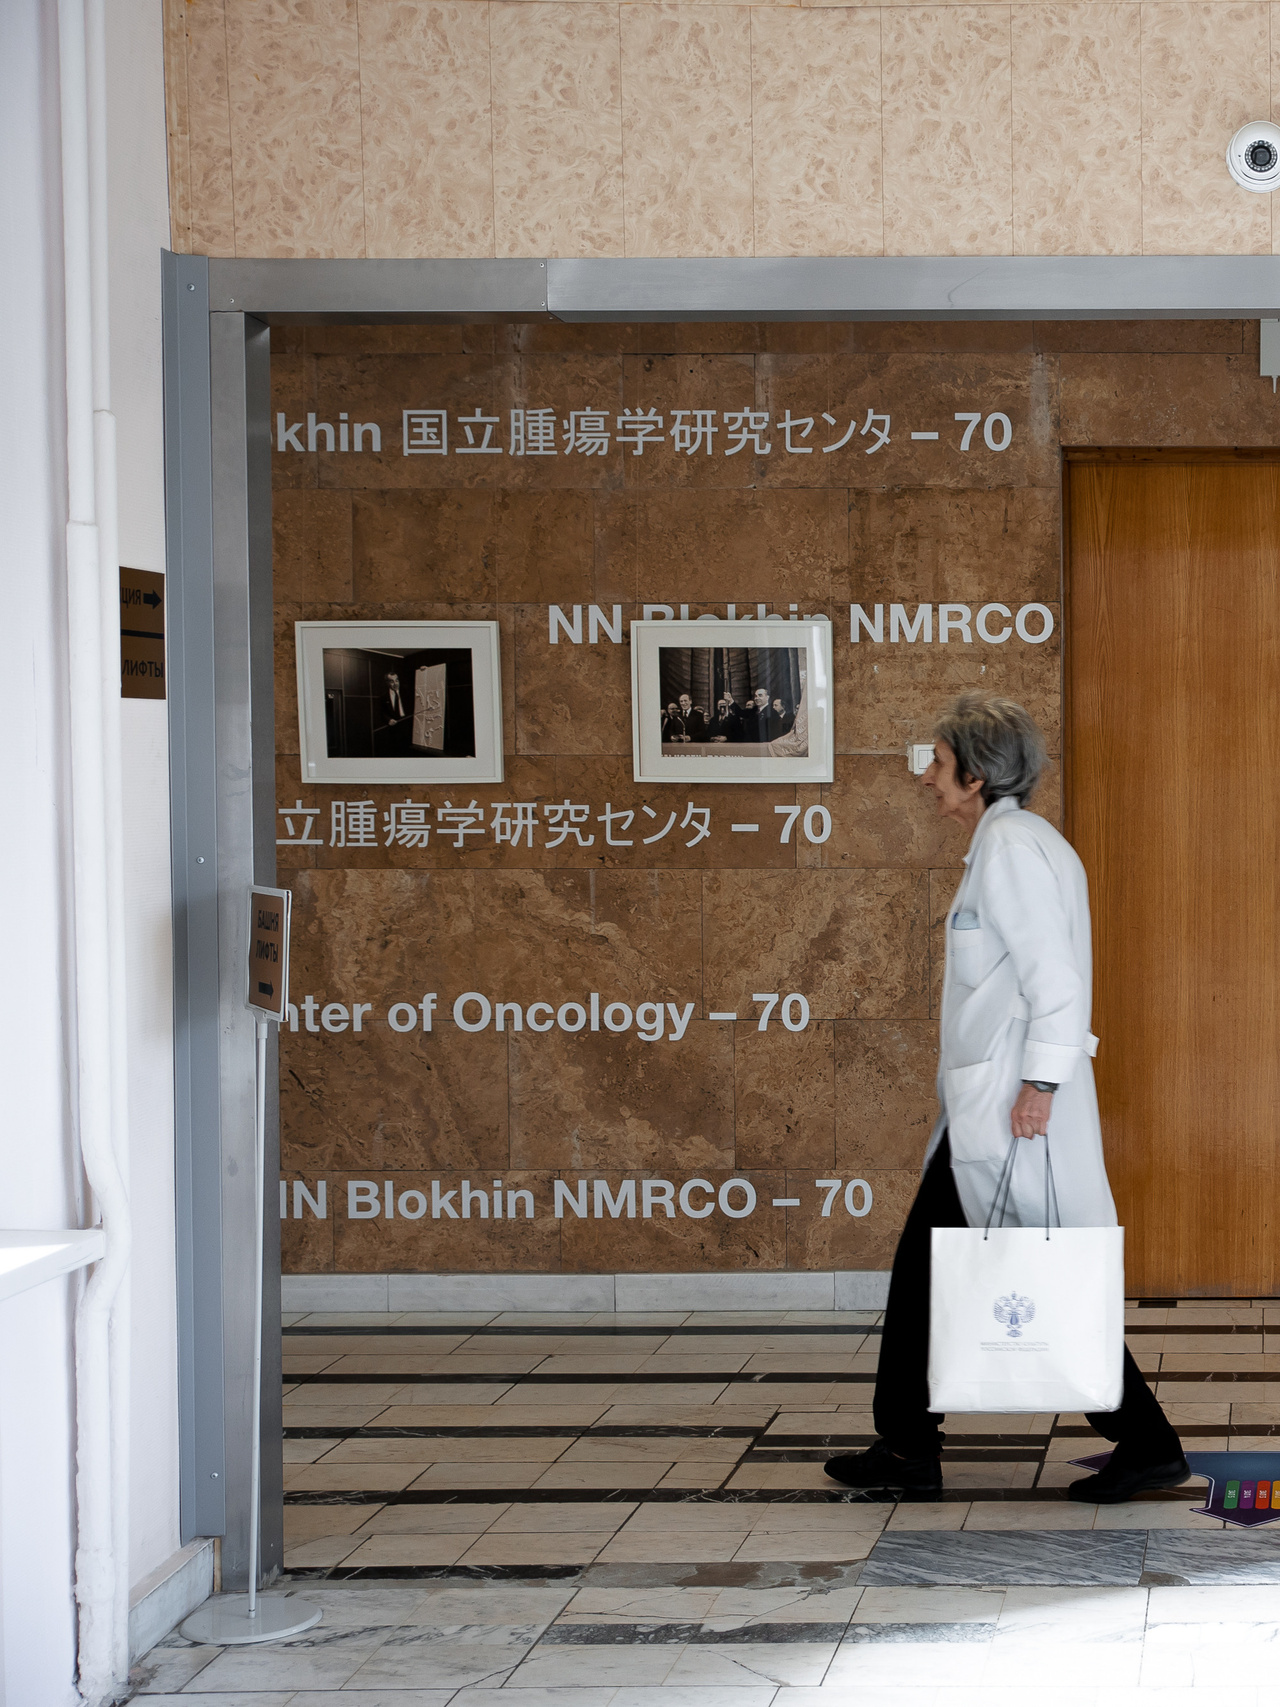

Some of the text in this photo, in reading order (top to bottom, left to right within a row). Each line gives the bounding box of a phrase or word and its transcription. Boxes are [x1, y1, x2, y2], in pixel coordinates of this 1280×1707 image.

[271, 412, 382, 452] khin
[402, 406, 891, 458] 国立腫瘍学研究センタ
[955, 412, 1013, 452] 70
[548, 604, 623, 645] NN
[849, 602, 1055, 645] NMRCO
[122, 659, 164, 679] ЛИФТЫ
[275, 798, 712, 850] 立腫瘍学研究センタ
[773, 804, 833, 845] 70
[257, 909, 280, 932] БАШНЯ
[255, 939, 279, 964] ЛИФТЫ
[387, 992, 438, 1033] of
[452, 991, 696, 1042] Oncology
[751, 992, 811, 1033] 70
[279, 1180, 327, 1220] N
[347, 1179, 536, 1221] Blokhin
[553, 1177, 757, 1219] NMRCO
[814, 1178, 874, 1218] 70
